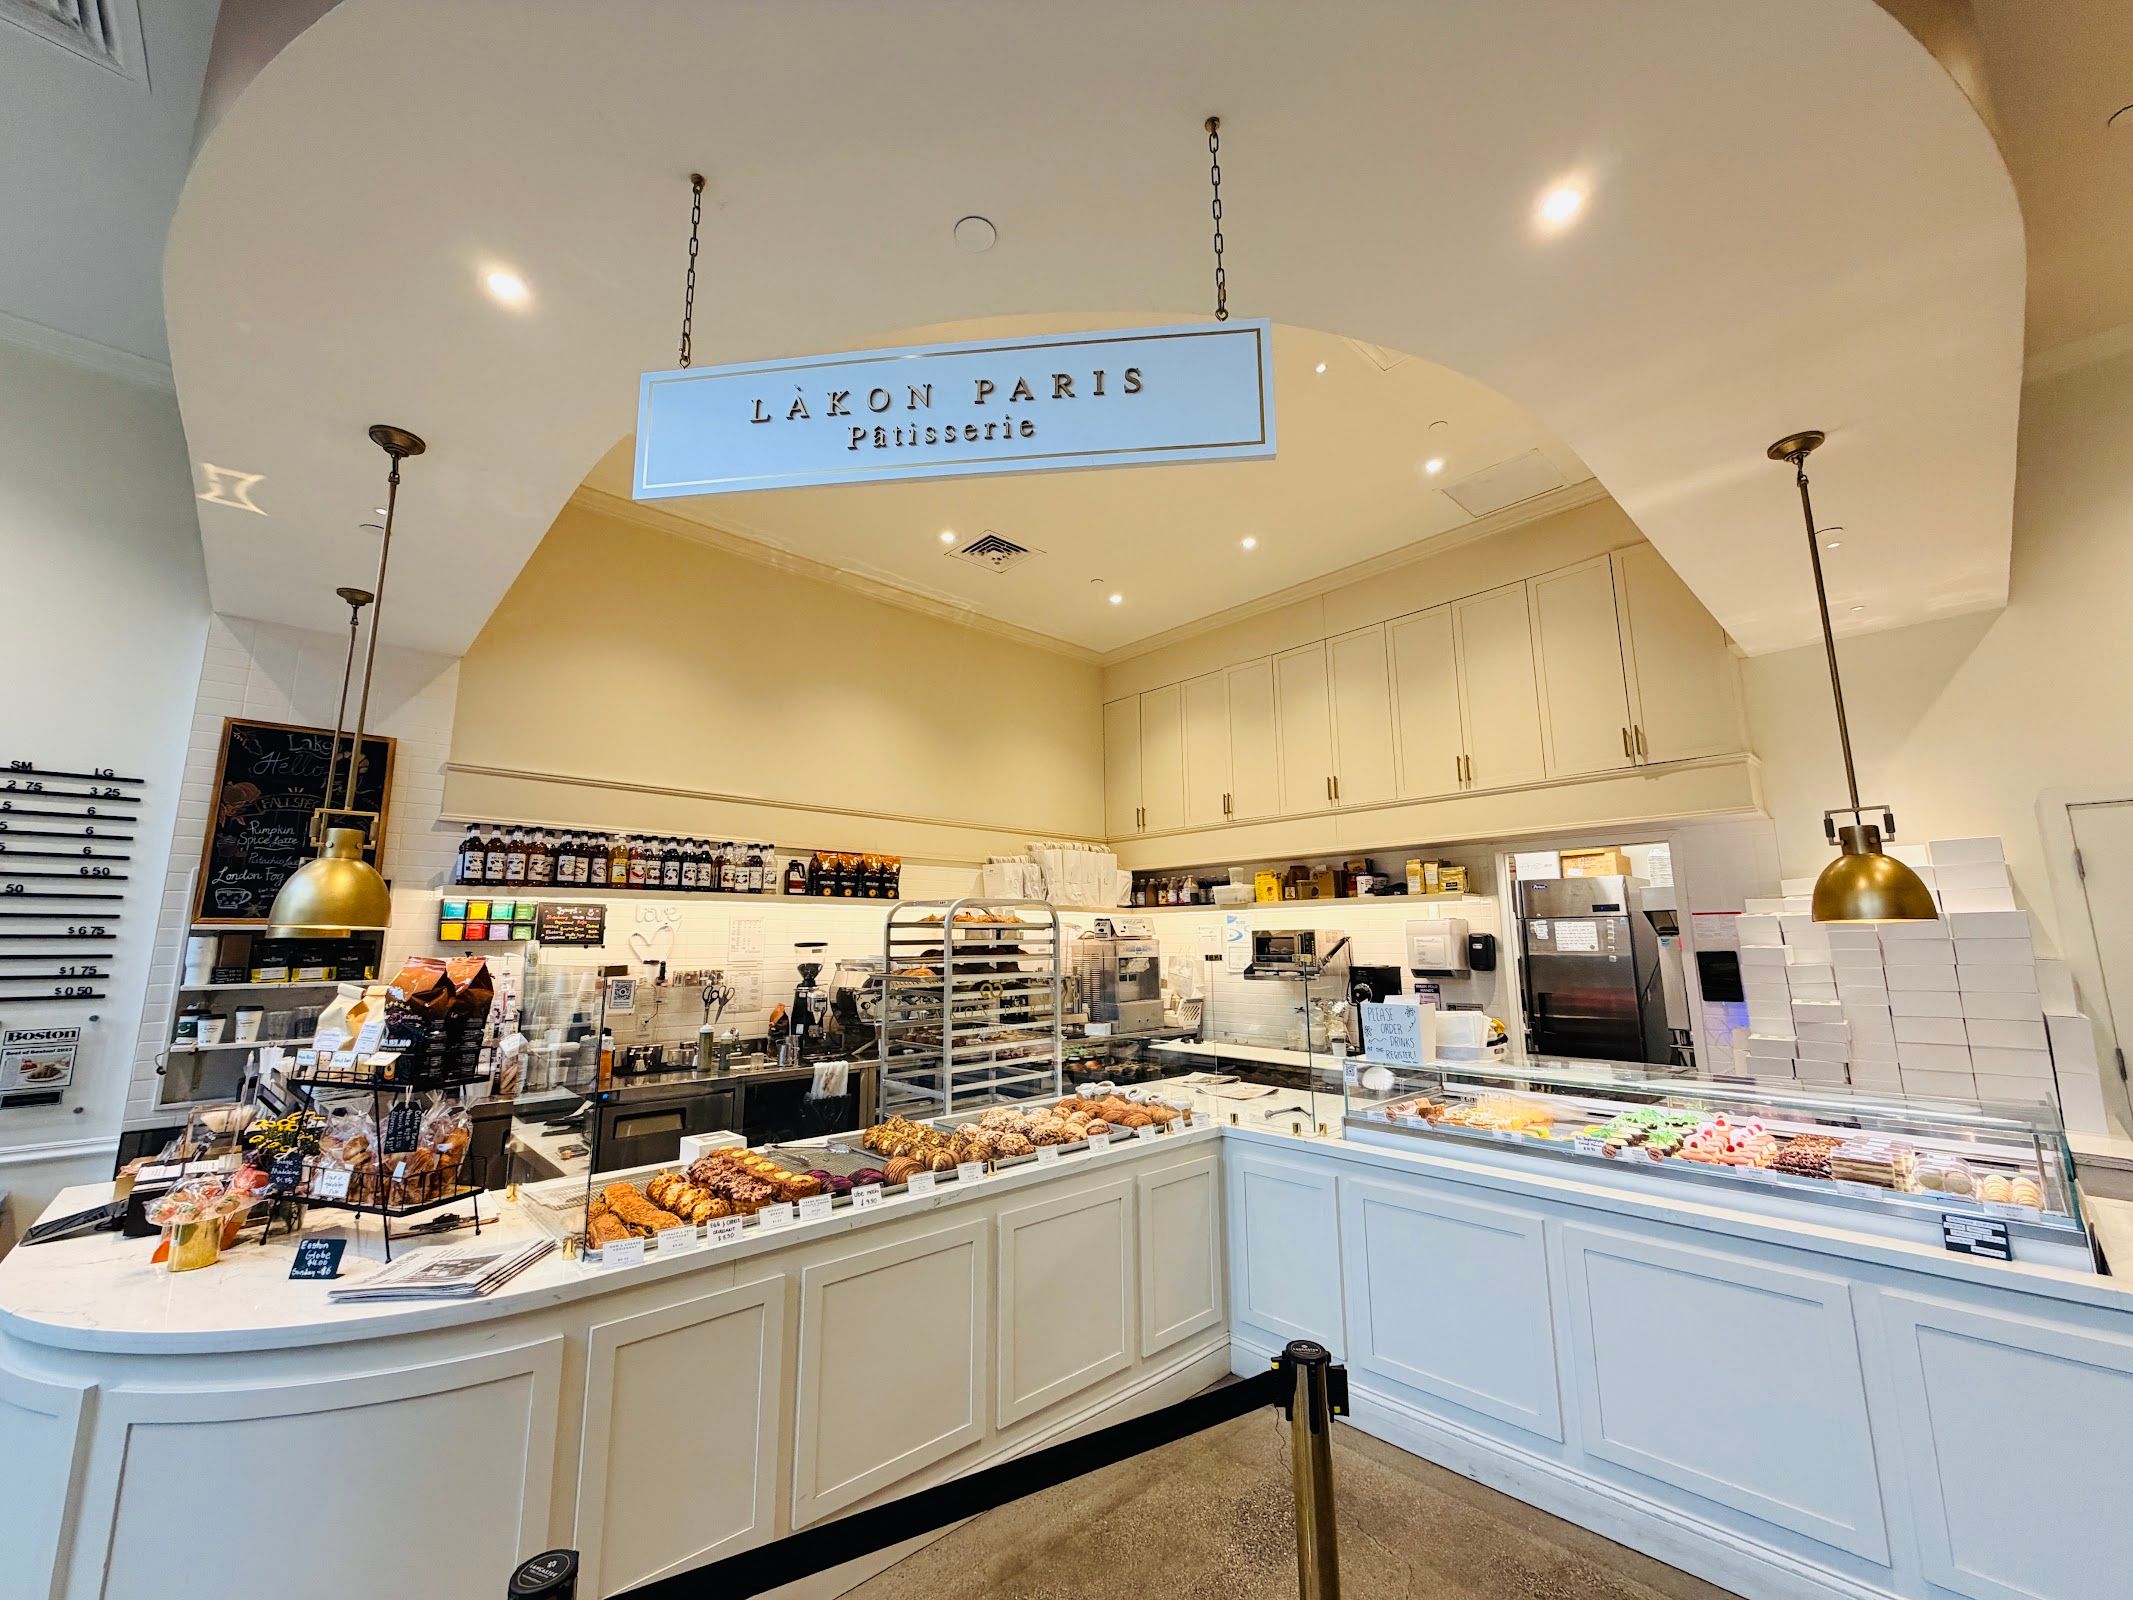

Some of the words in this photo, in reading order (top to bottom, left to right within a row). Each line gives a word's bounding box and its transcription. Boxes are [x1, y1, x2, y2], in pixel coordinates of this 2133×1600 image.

[750, 381, 932, 424] LÀKON
[974, 367, 1144, 405] PARIS
[847, 413, 1035, 451] Pâtisserie
[10, 760, 33, 771] SM
[94, 767, 114, 778] LG
[253, 751, 324, 776] Hello
[87, 806, 96, 816] 6
[85, 826, 94, 835] 6
[247, 820, 295, 838] Pumpkin
[237, 832, 270, 851] Spice
[268, 836, 300, 847] Latte
[83, 846, 92, 855] 6
[211, 866, 262, 884] London
[265, 866, 285, 886] Fog
[1367, 1007, 1394, 1021] PLEASE
[1380, 1023, 1403, 1035] ORDER
[6, 1030, 77, 1043] Boston
[1389, 1036, 1415, 1048] DRINKS
[305, 1250, 331, 1260] Globe
